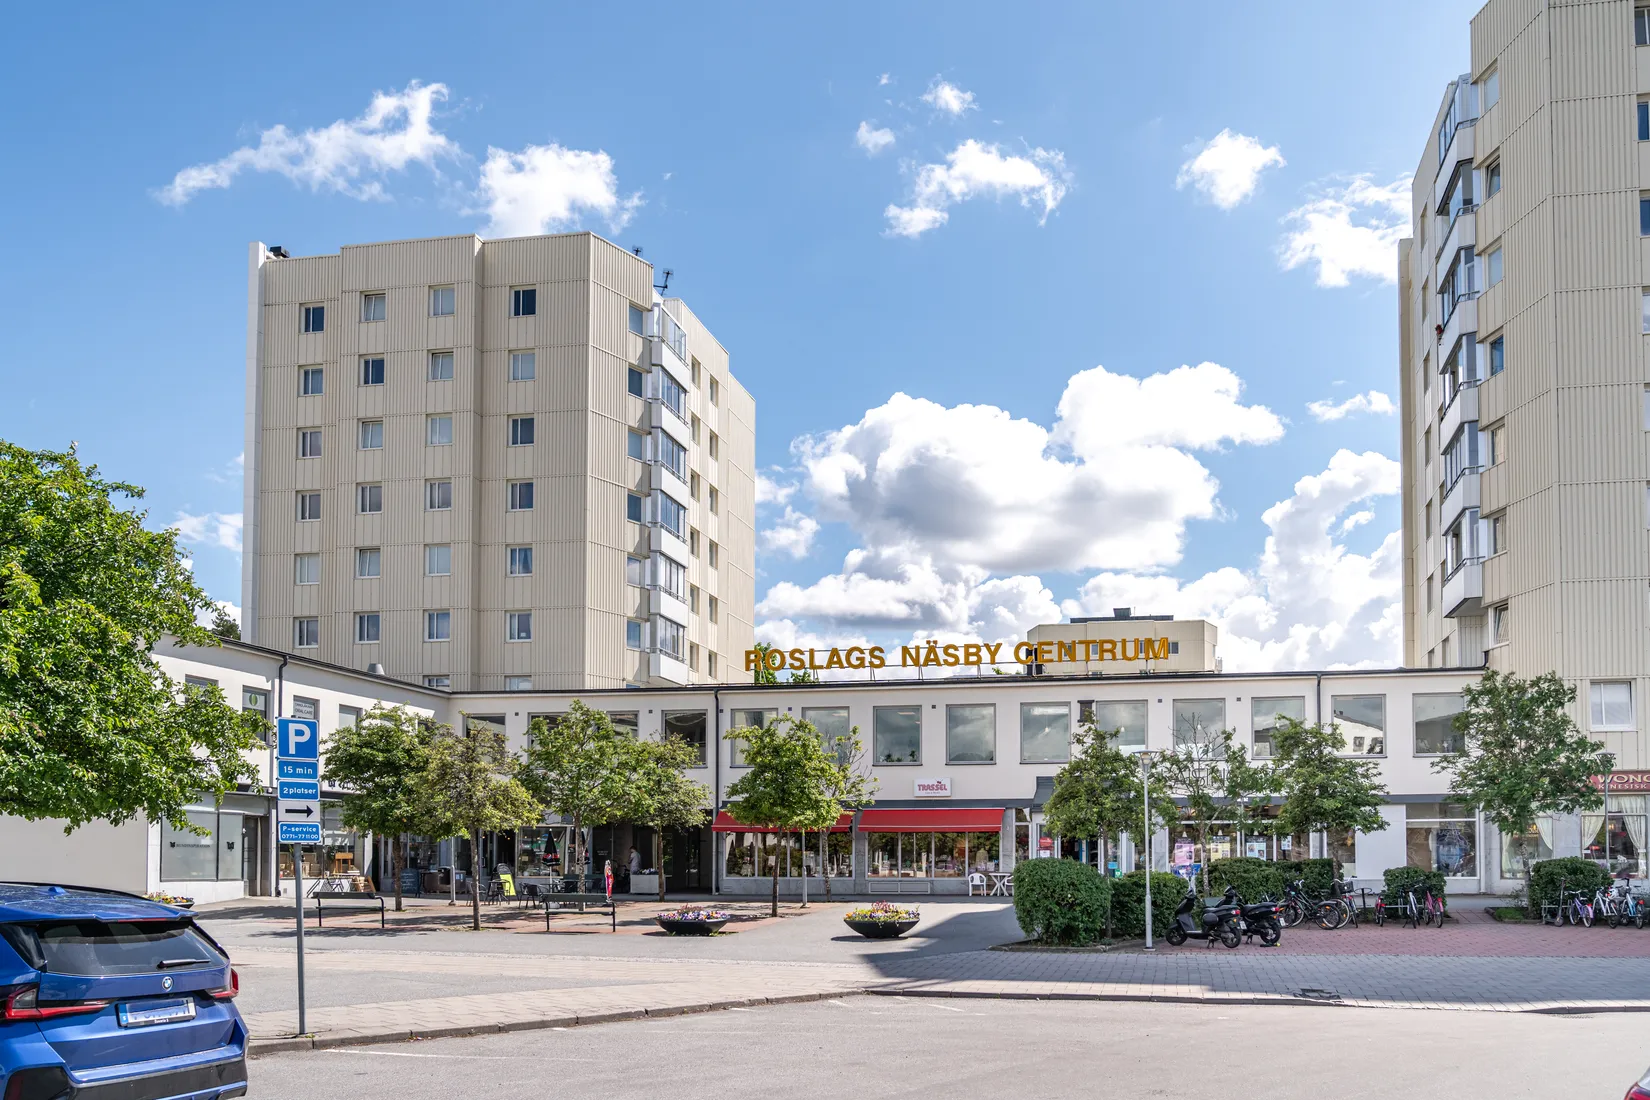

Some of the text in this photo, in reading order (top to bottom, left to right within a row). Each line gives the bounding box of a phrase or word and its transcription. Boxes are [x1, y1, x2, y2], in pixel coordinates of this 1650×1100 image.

[744, 636, 1169, 672] ROSLAGS NÄSBY CENTRUM
[288, 722, 311, 755] P
[283, 765, 313, 774] 15 min
[289, 787, 316, 795] platser
[917, 783, 948, 792] TRASSEL
